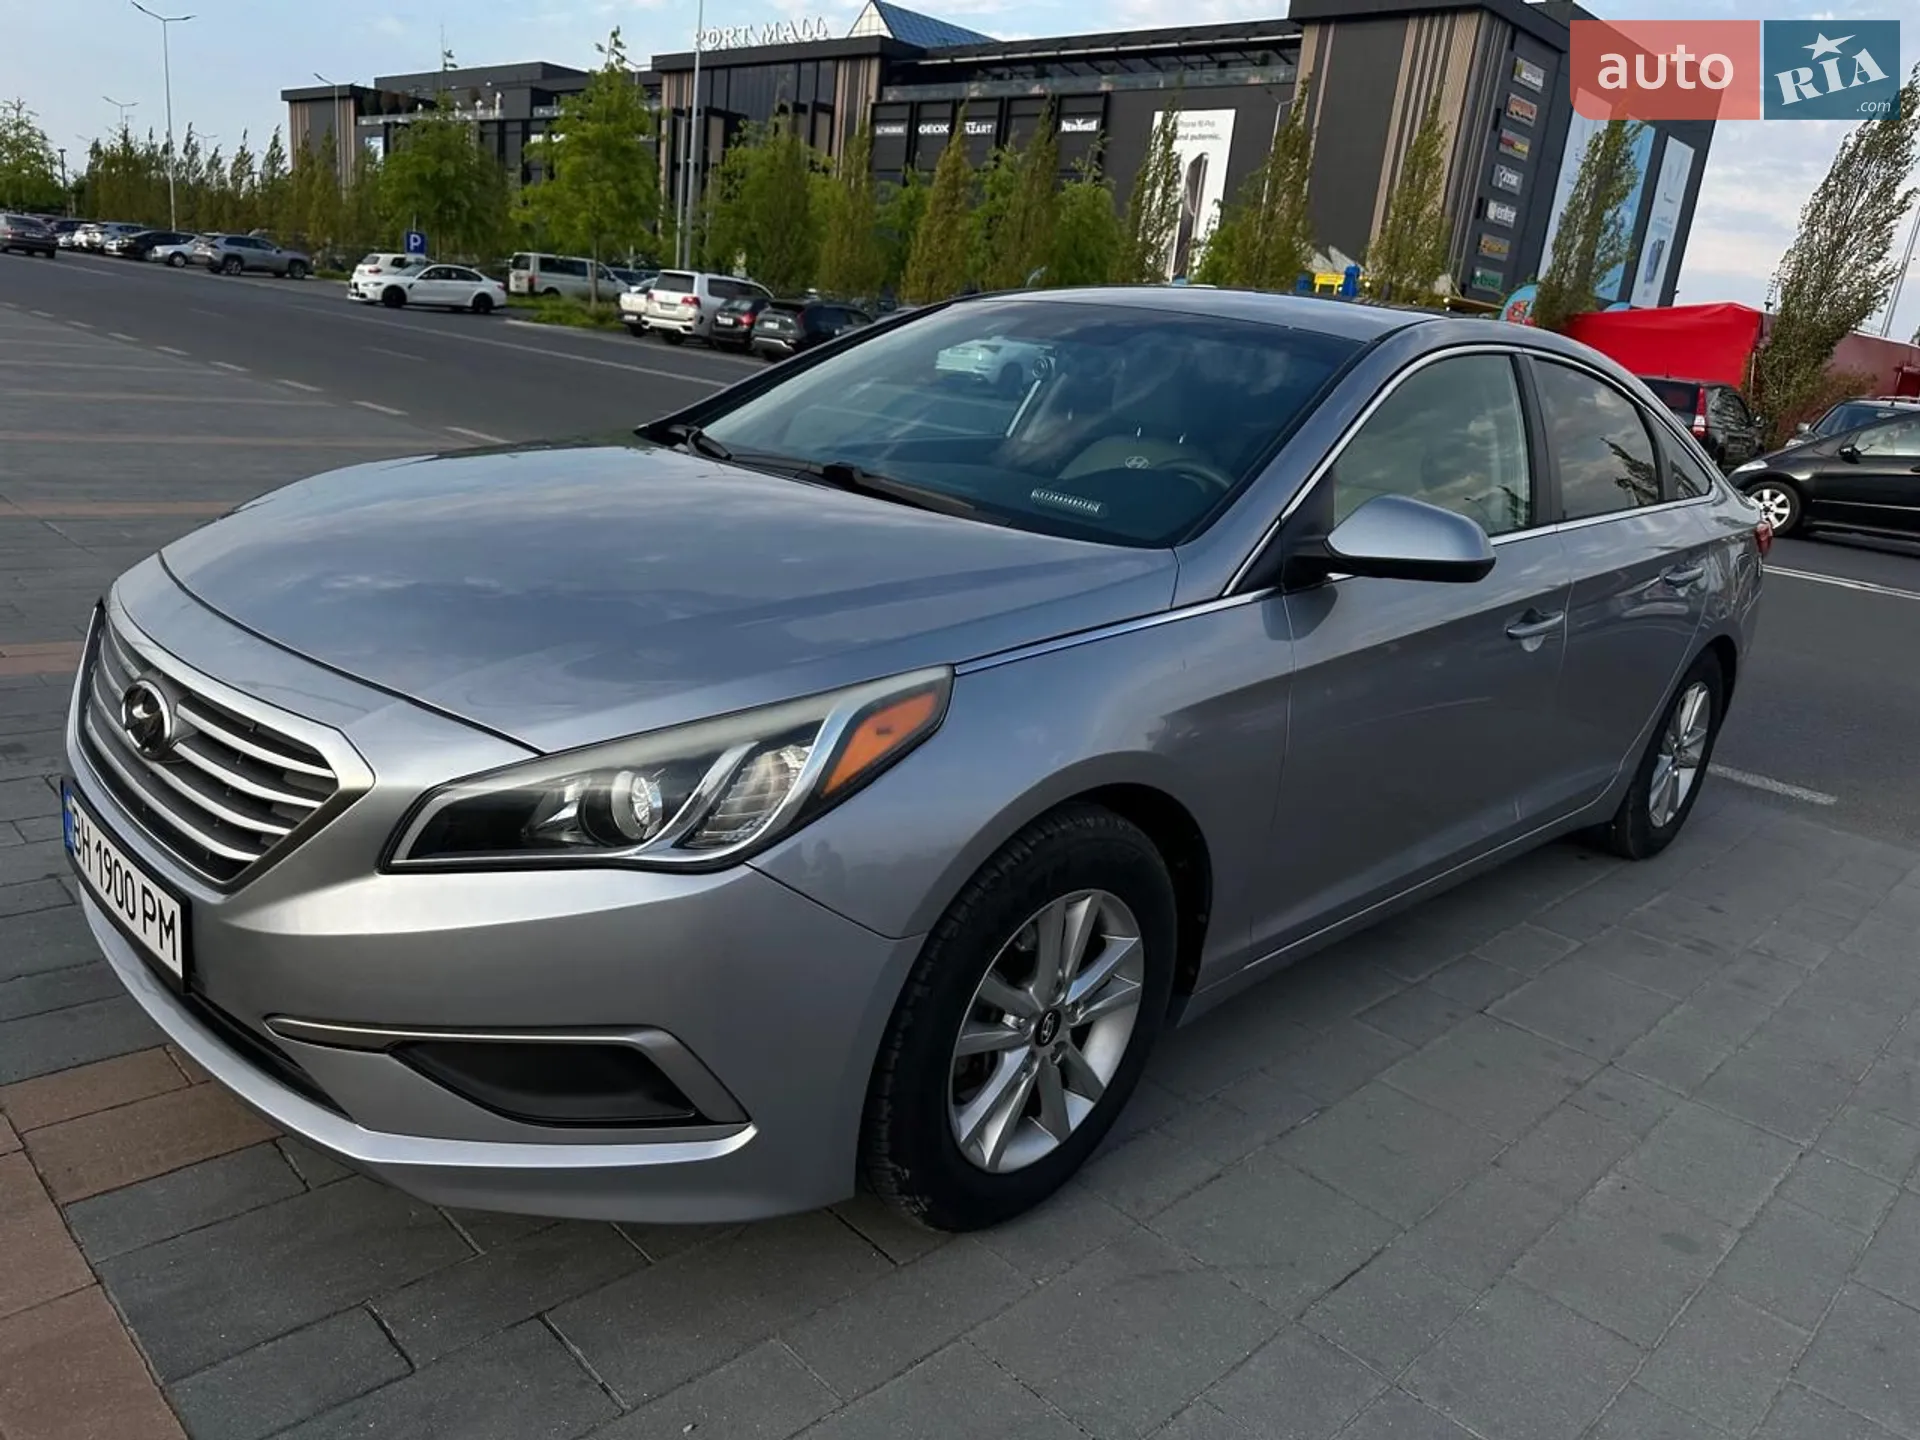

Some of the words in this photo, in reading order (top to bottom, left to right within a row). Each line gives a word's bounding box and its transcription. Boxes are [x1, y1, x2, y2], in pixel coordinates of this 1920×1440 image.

[695, 23, 755, 52] PORT
[762, 16, 829, 47] MALL
[918, 124, 950, 134] GEOX
[410, 233, 421, 250] P
[95, 840, 136, 921] 1900
[141, 885, 177, 961] PM
